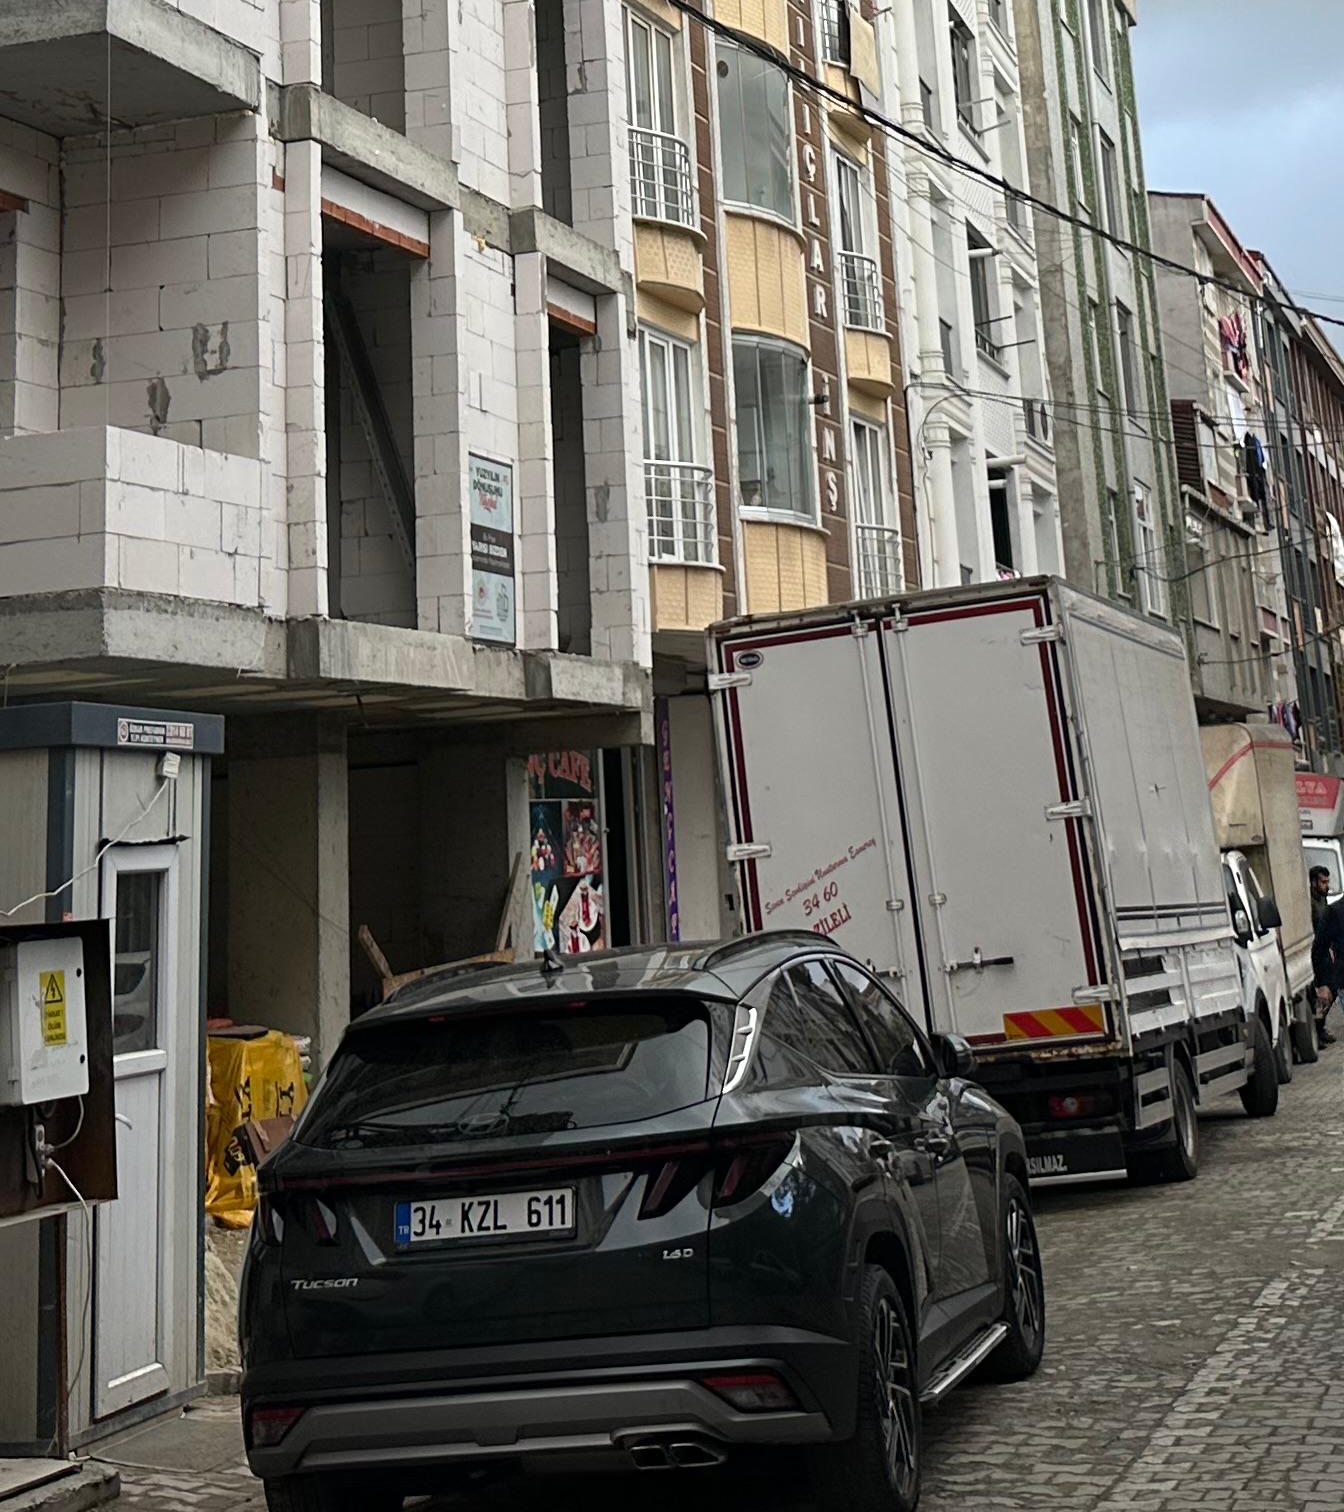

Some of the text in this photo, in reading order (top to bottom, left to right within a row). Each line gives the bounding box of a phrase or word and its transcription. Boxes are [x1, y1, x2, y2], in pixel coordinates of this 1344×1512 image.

[548, 749, 593, 792] CAFE
[803, 893, 820, 916] 34
[823, 881, 838, 902] 60
[398, 1225, 410, 1236] TR
[413, 1194, 566, 1237] 34 KZL 611
